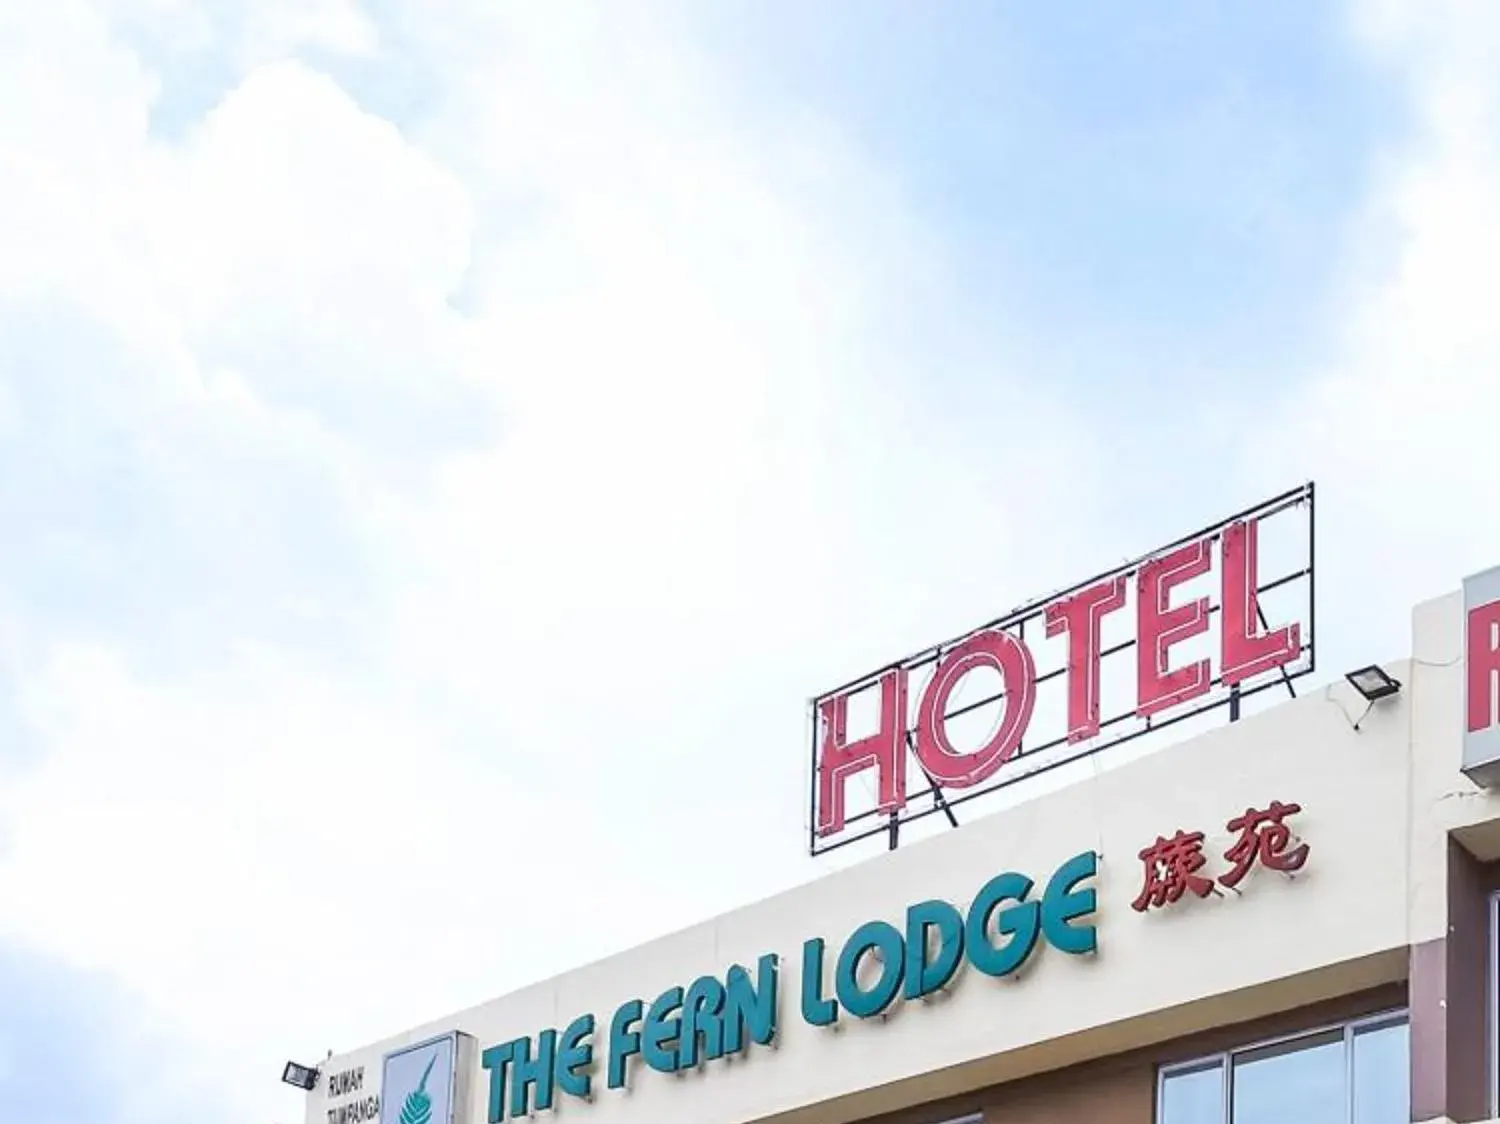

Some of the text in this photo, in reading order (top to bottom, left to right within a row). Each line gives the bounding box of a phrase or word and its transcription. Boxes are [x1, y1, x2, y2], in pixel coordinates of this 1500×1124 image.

[817, 518, 1301, 837] HOTEL
[482, 850, 1098, 1124] THE FERN LODGE
